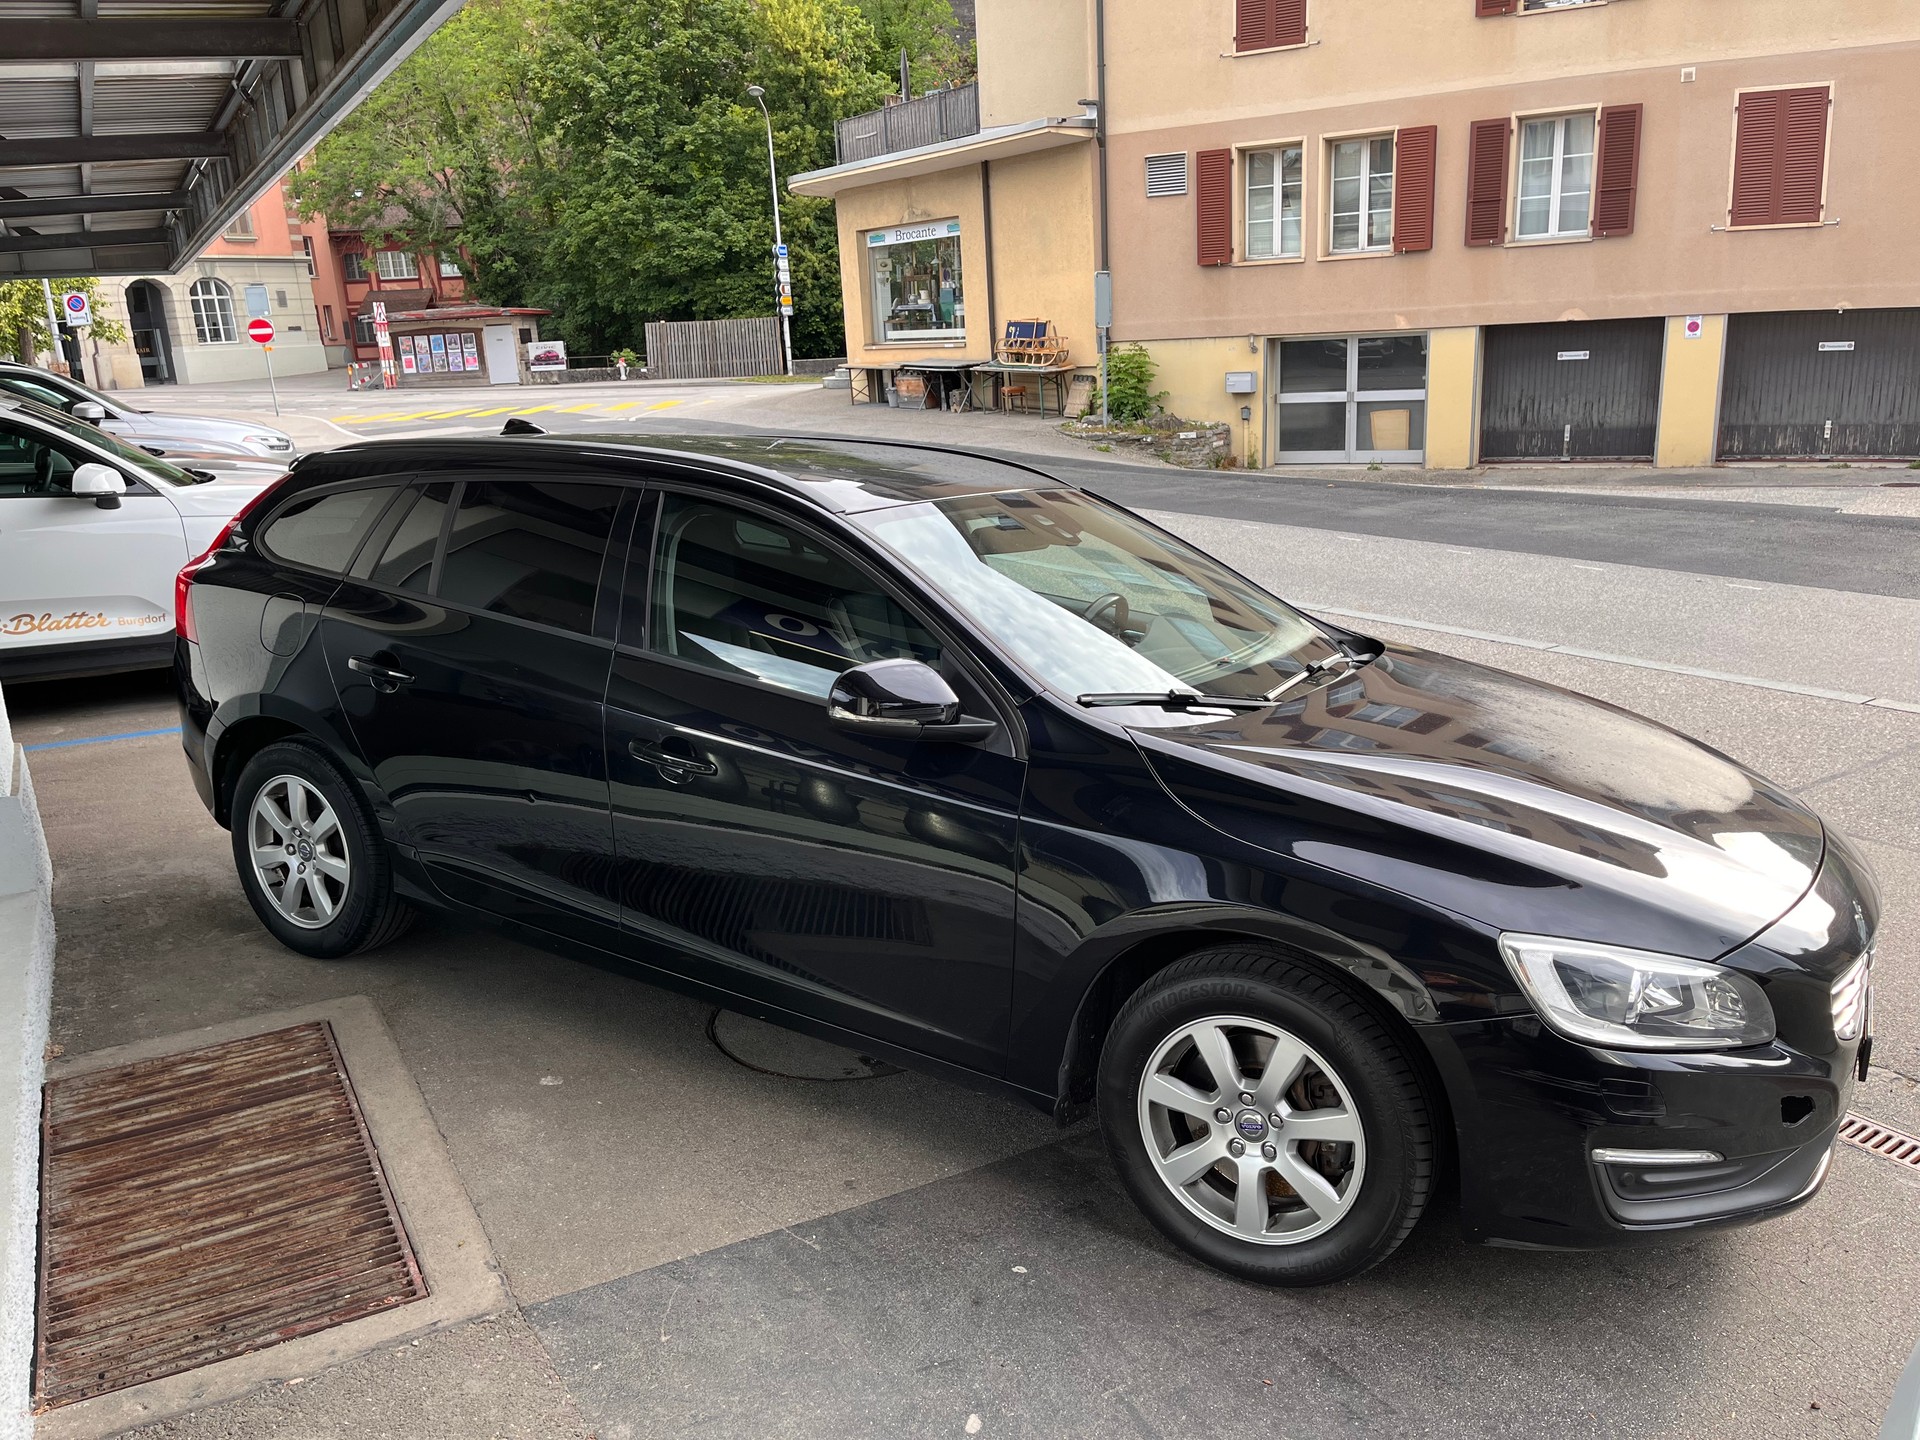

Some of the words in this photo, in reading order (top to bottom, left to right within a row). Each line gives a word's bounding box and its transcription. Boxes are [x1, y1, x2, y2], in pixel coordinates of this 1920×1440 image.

[895, 227, 936, 242] Brocante
[3, 611, 112, 636] Blatter
[118, 613, 166, 627] Burgdorf
[1140, 983, 1258, 1019] BRIDGESTONE
